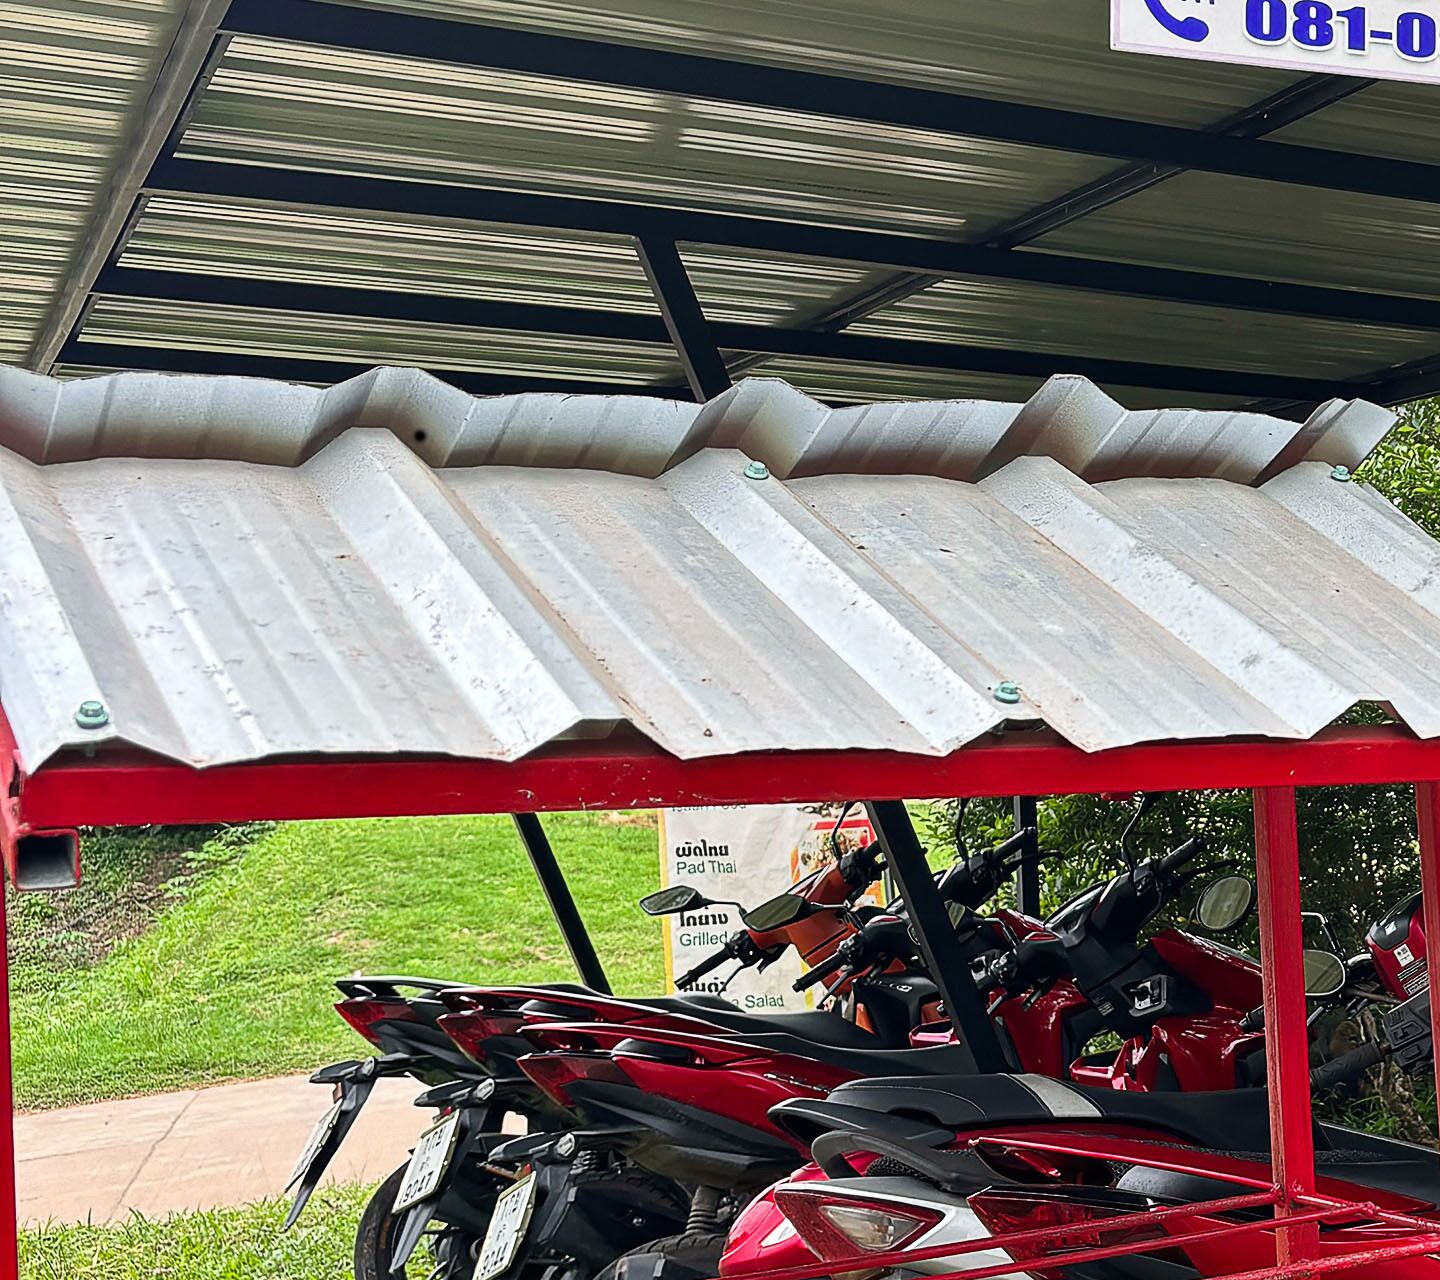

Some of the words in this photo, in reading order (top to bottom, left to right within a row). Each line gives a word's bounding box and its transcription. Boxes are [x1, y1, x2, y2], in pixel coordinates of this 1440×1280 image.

[675, 838, 729, 857] ผัดไทย
[676, 860, 706, 875] Pad
[708, 859, 737, 874] Thai
[679, 930, 728, 947] Grilled
[744, 994, 785, 1009] Salad
